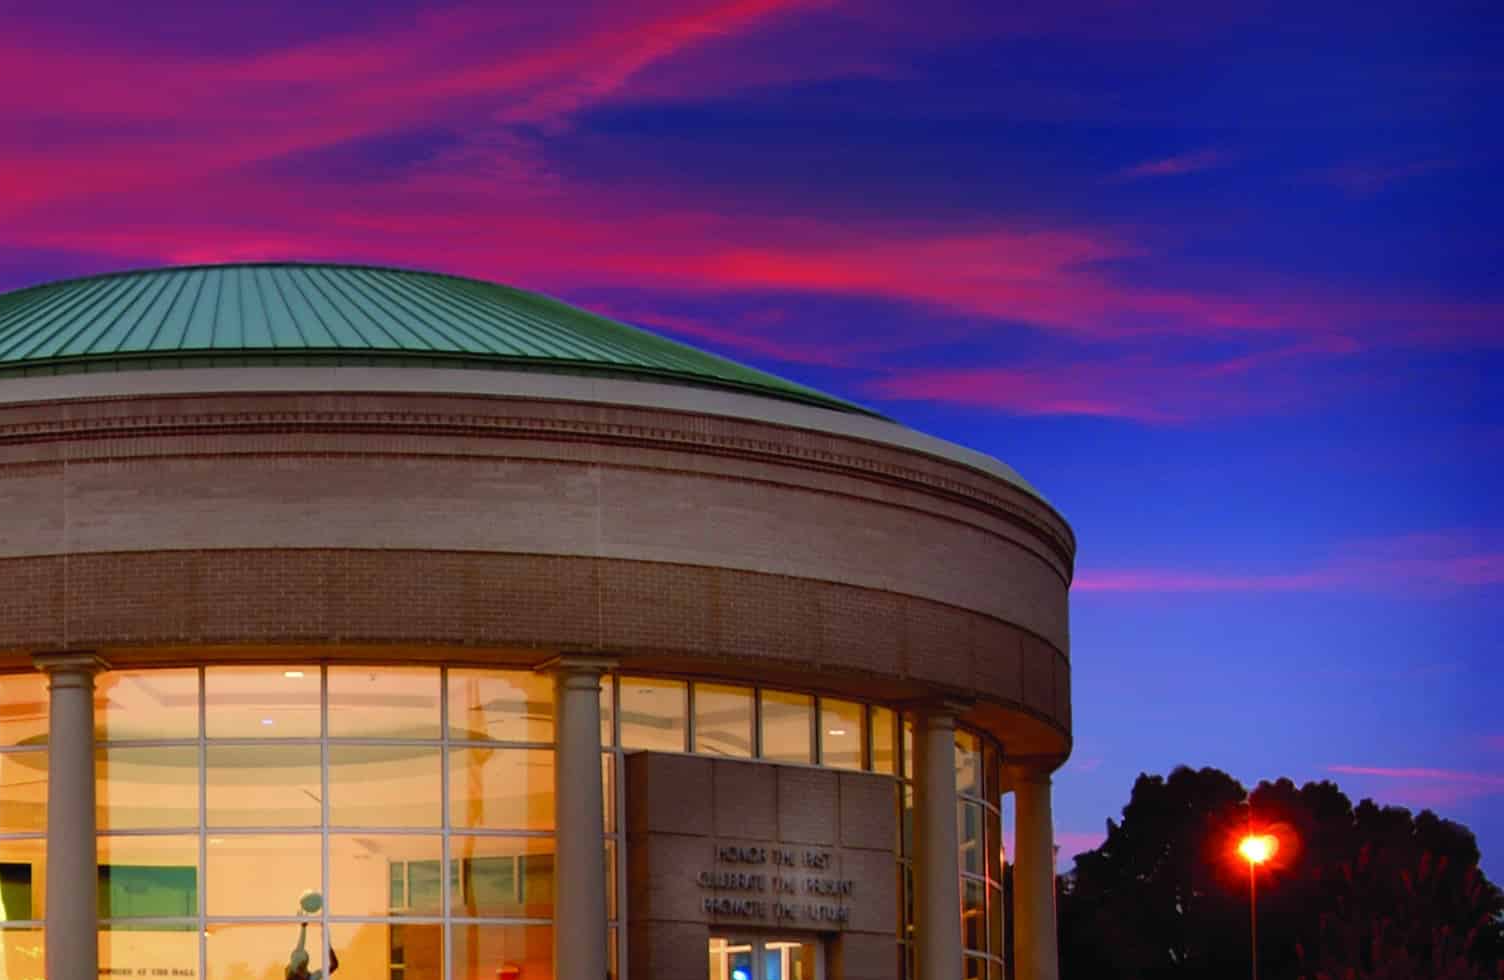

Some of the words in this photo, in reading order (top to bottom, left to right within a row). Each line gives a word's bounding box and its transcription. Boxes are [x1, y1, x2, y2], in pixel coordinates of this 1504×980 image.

[715, 846, 767, 865] HONOR
[696, 871, 767, 892] CELEBRATE
[701, 896, 767, 920] PROMOTE
